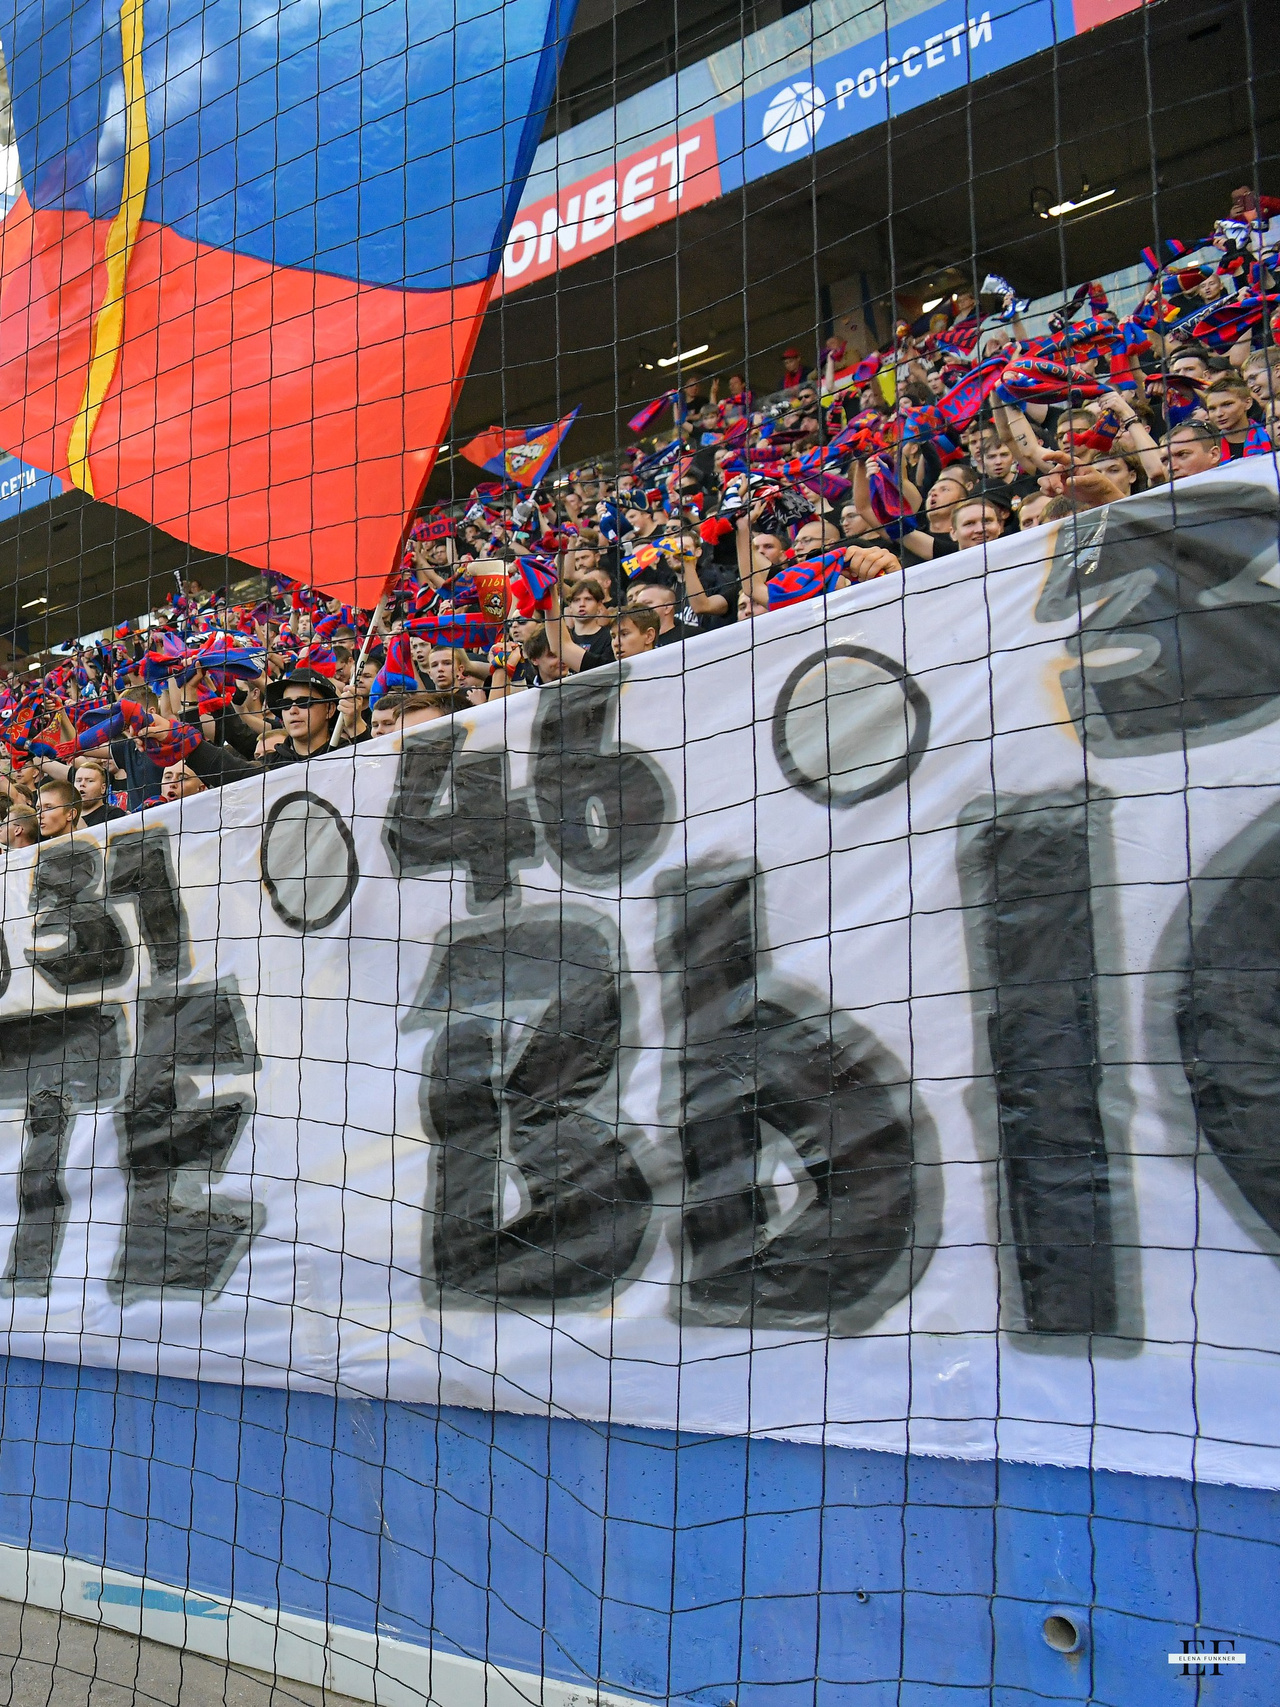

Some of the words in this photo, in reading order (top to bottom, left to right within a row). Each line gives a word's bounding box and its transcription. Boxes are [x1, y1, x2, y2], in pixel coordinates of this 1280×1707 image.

[836, 11, 993, 111] РОССЕТИ
[500, 135, 700, 278] ONBET
[381, 664, 676, 916] 46
